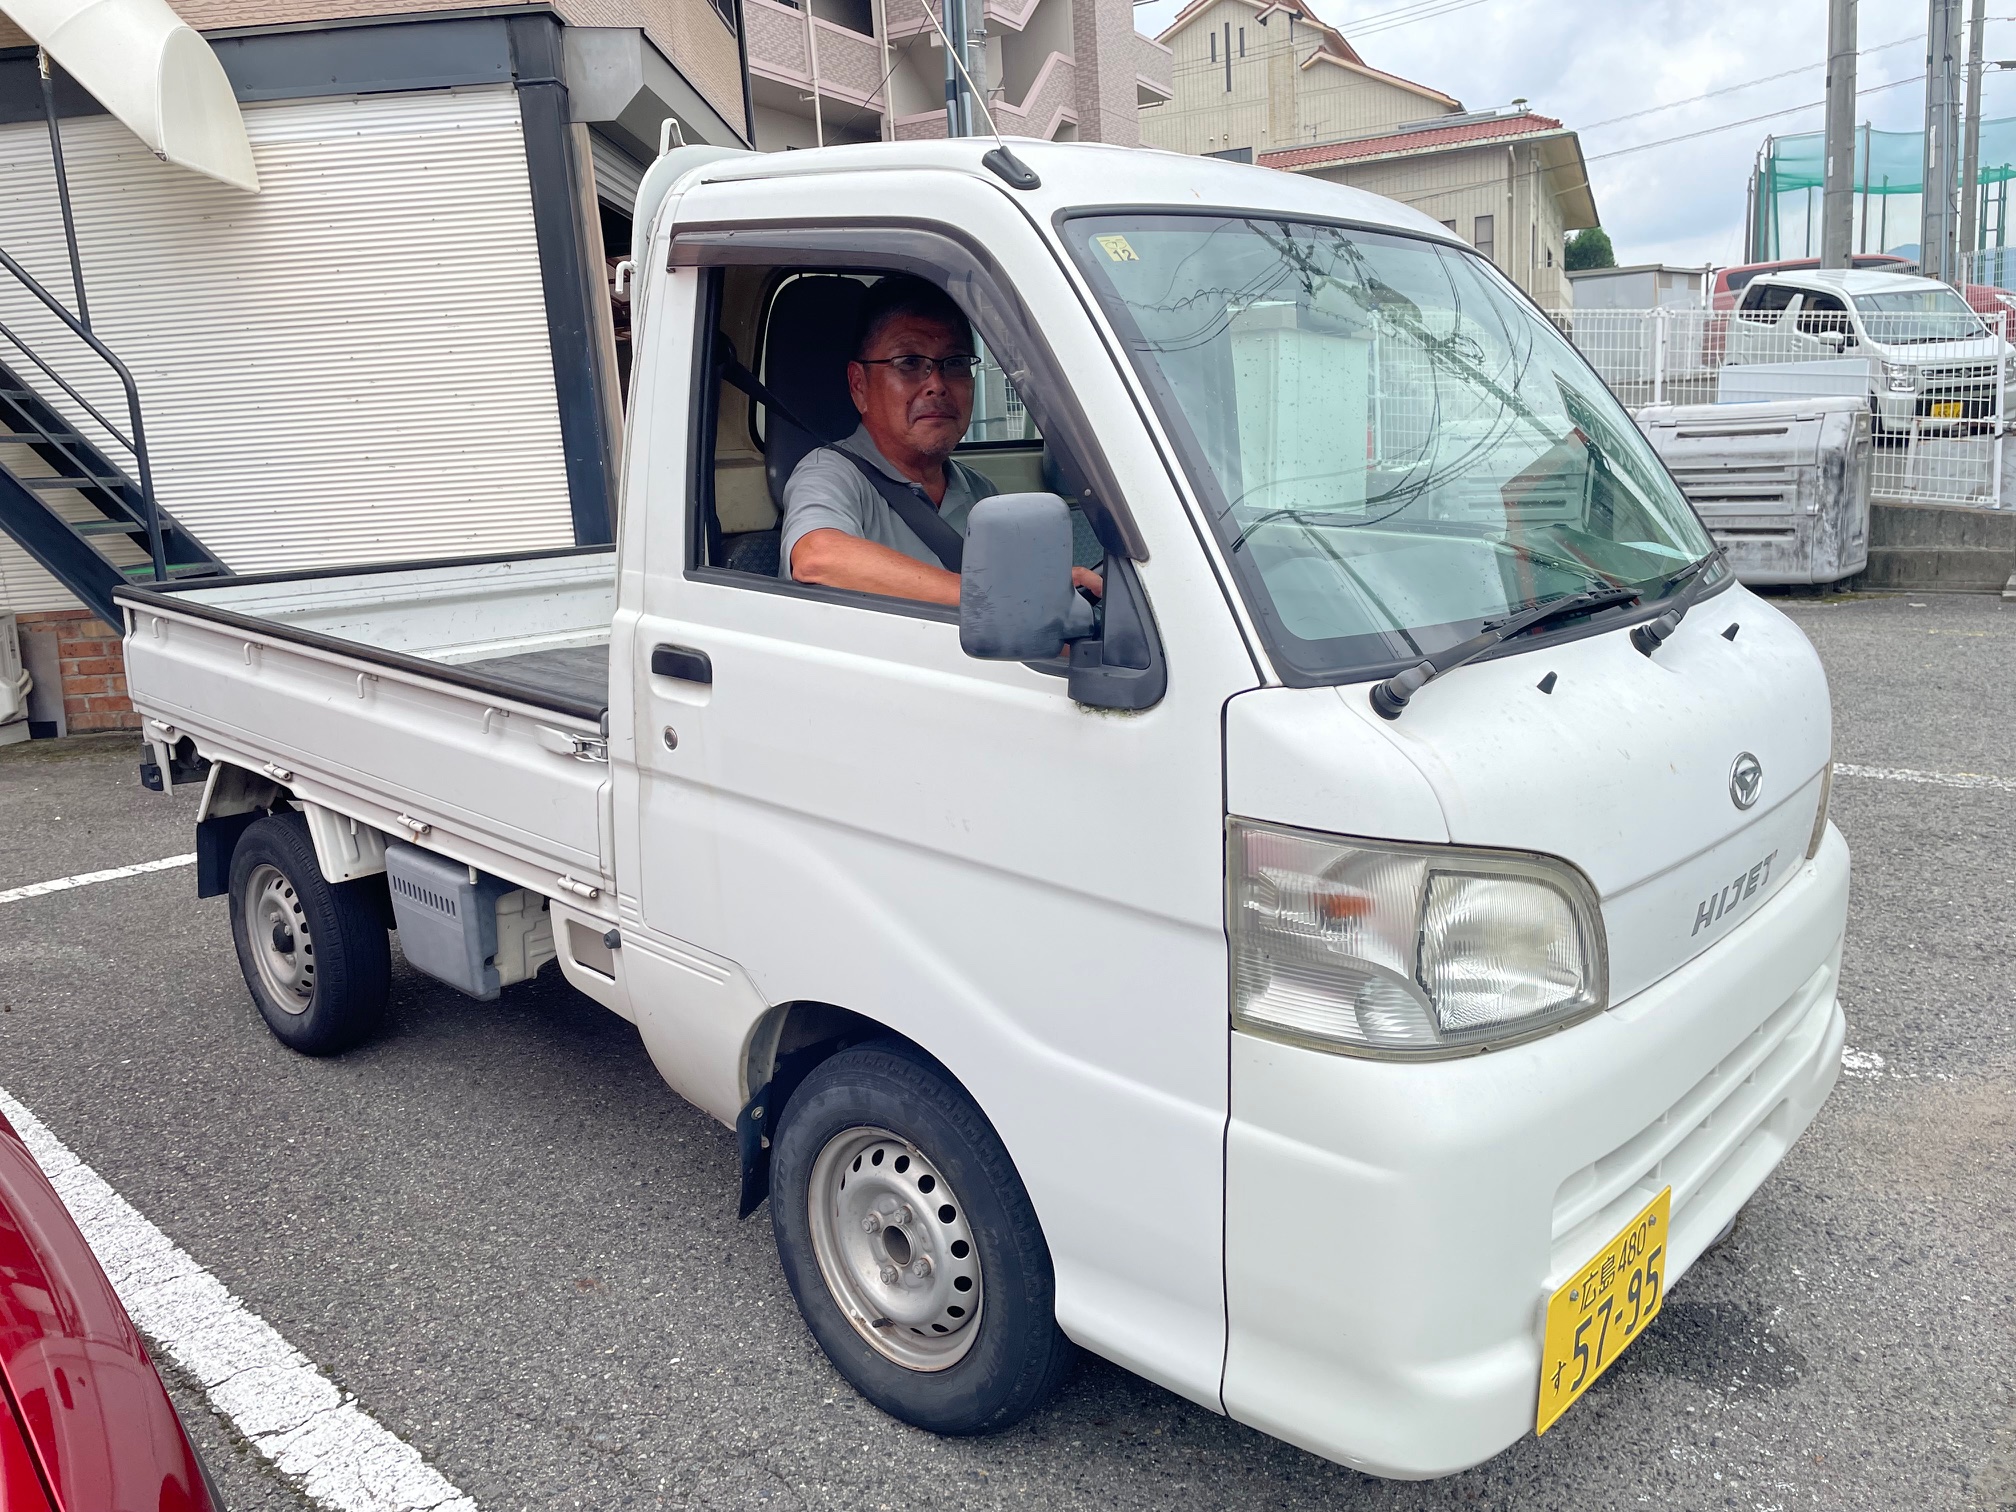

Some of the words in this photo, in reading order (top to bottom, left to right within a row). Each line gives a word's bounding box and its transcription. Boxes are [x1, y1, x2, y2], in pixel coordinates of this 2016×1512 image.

[1113, 249, 1136, 261] 12
[1691, 849, 1778, 937] HIJET
[1580, 1254, 1615, 1314] 広島
[1617, 1221, 1648, 1273] 480
[1550, 1360, 1567, 1397] す
[1570, 1244, 1662, 1393] 57-95
